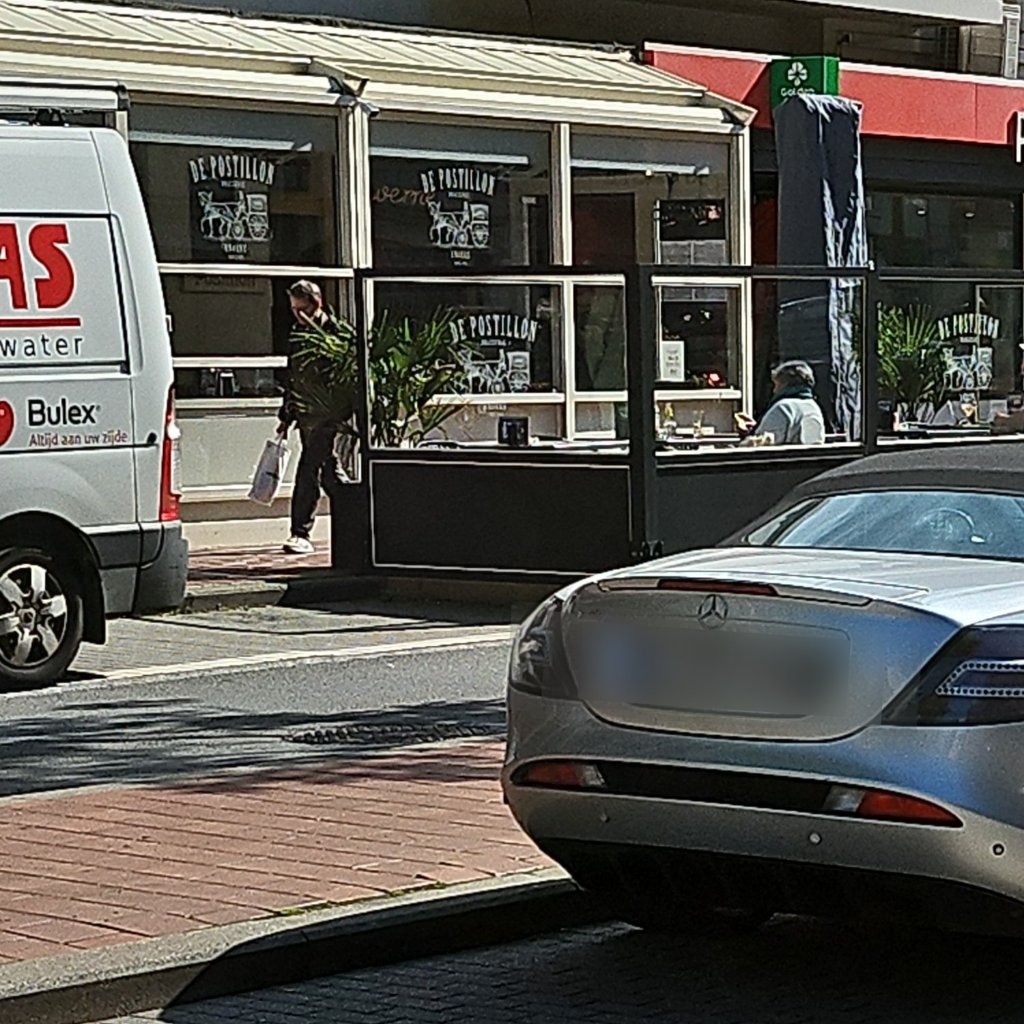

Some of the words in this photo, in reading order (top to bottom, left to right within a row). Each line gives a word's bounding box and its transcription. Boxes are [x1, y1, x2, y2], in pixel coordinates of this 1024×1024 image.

[188, 157, 208, 183] DE
[210, 155, 275, 185] POSTILLON
[420, 170, 438, 193] DE
[438, 168, 496, 196] POSTILLON
[449, 319, 467, 344] DE
[469, 314, 538, 343] POSTILLON
[28, 398, 96, 426] Bulex
[29, 432, 59, 447] Altijd
[62, 435, 82, 446] aan
[84, 434, 100, 445] uw
[102, 430, 128, 444] zijde
